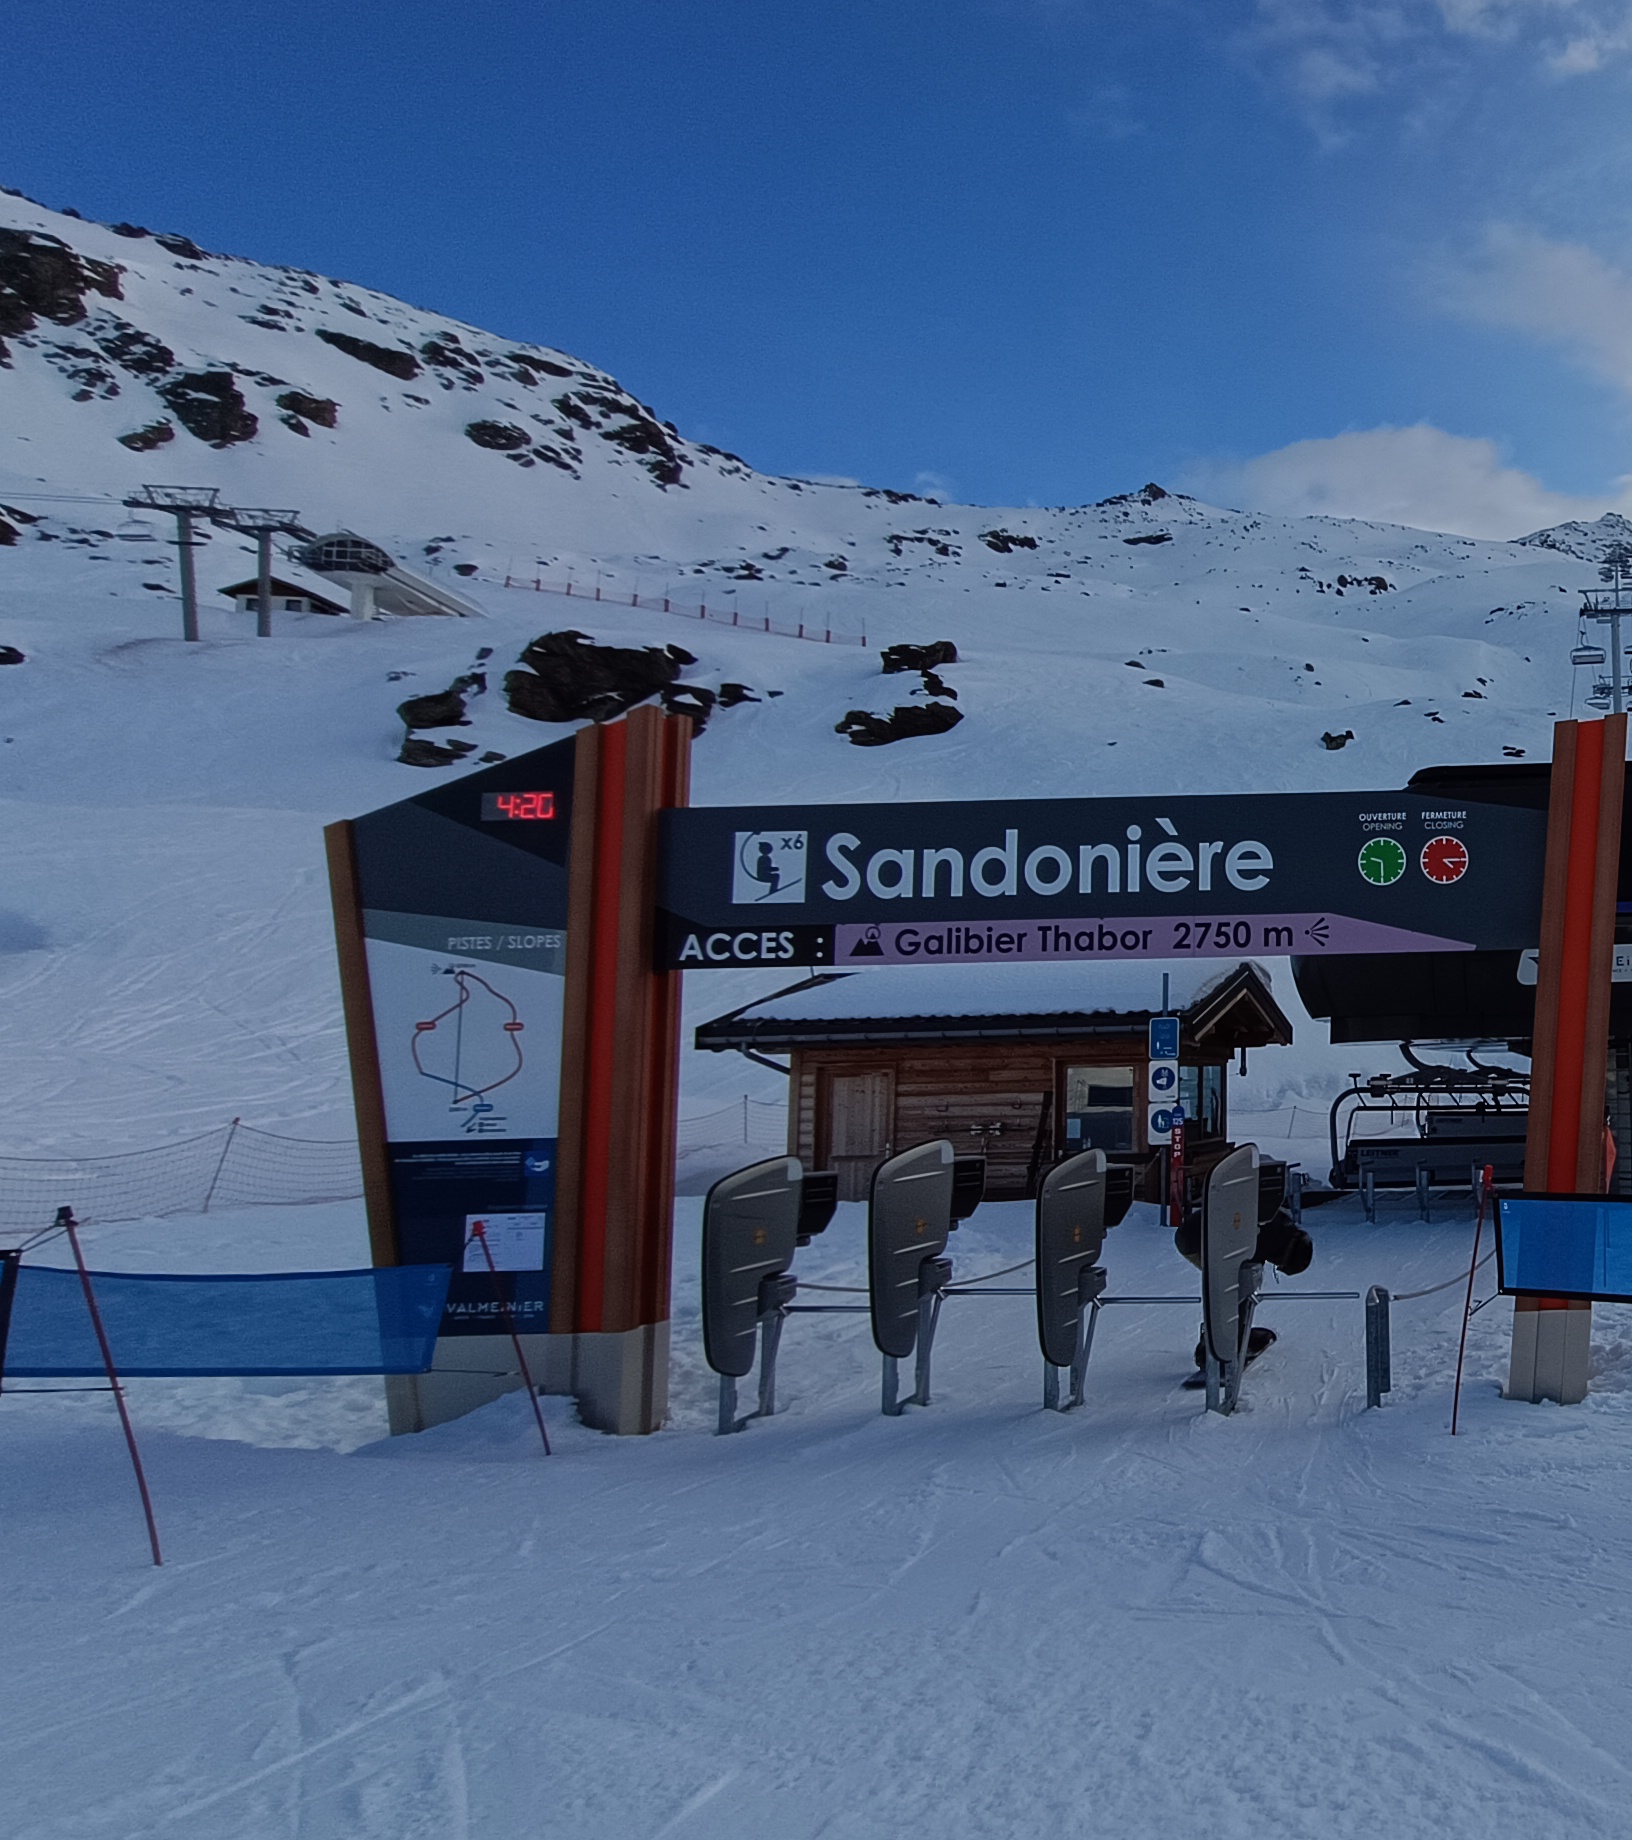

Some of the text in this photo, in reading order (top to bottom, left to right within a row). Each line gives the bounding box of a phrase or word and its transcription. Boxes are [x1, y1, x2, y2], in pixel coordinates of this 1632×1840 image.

[496, 793, 555, 819] 4:20
[1359, 812, 1407, 822] OUVERTURE
[1421, 811, 1467, 820] FERMETURE
[1362, 822, 1403, 831] OPENING
[1424, 820, 1464, 830] CLOSING
[780, 834, 804, 850] x6
[822, 818, 1274, 900] Sandonière
[448, 936, 493, 950] PISTES
[507, 935, 562, 949] SLOPES
[679, 931, 795, 960] ACCES
[895, 926, 1028, 956] Galibier
[1038, 924, 1153, 952] Thabor
[1173, 921, 1251, 950] 2750
[1263, 925, 1294, 947] m
[1173, 1127, 1182, 1158] STOP
